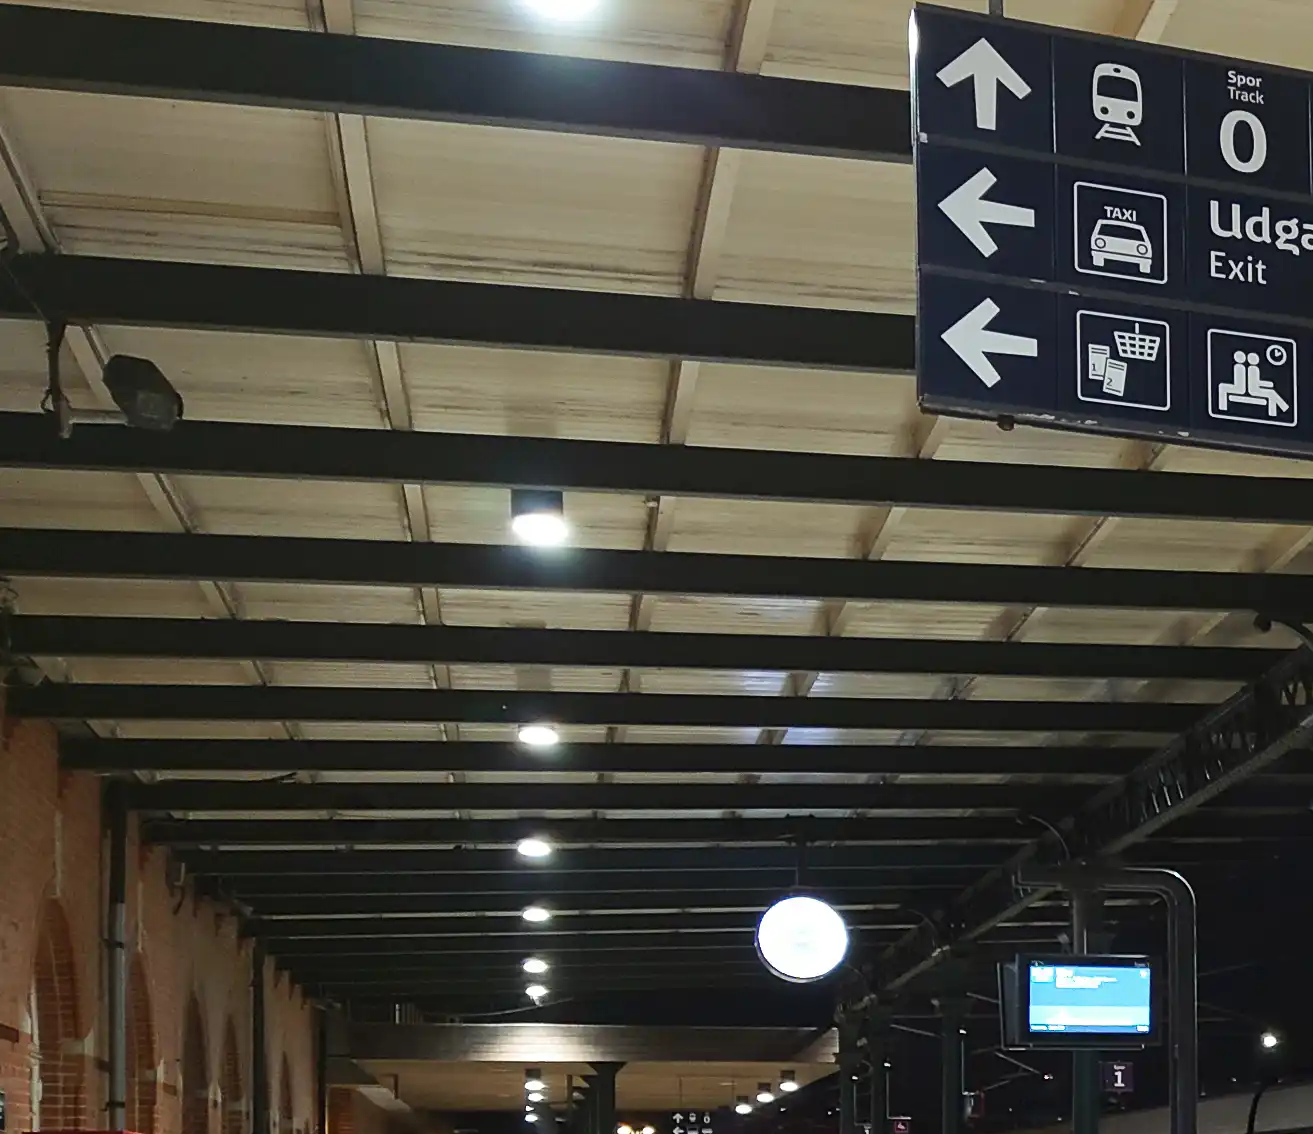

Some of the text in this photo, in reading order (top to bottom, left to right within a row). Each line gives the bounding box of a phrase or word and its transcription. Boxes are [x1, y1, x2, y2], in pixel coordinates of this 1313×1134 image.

[1227, 70, 1263, 88] Spor
[1227, 86, 1265, 105] Track
[1220, 109, 1268, 174] 0
[1103, 205, 1137, 222] TAXI
[1210, 250, 1267, 285] Exit
[1113, 1071, 1126, 1087] 1
